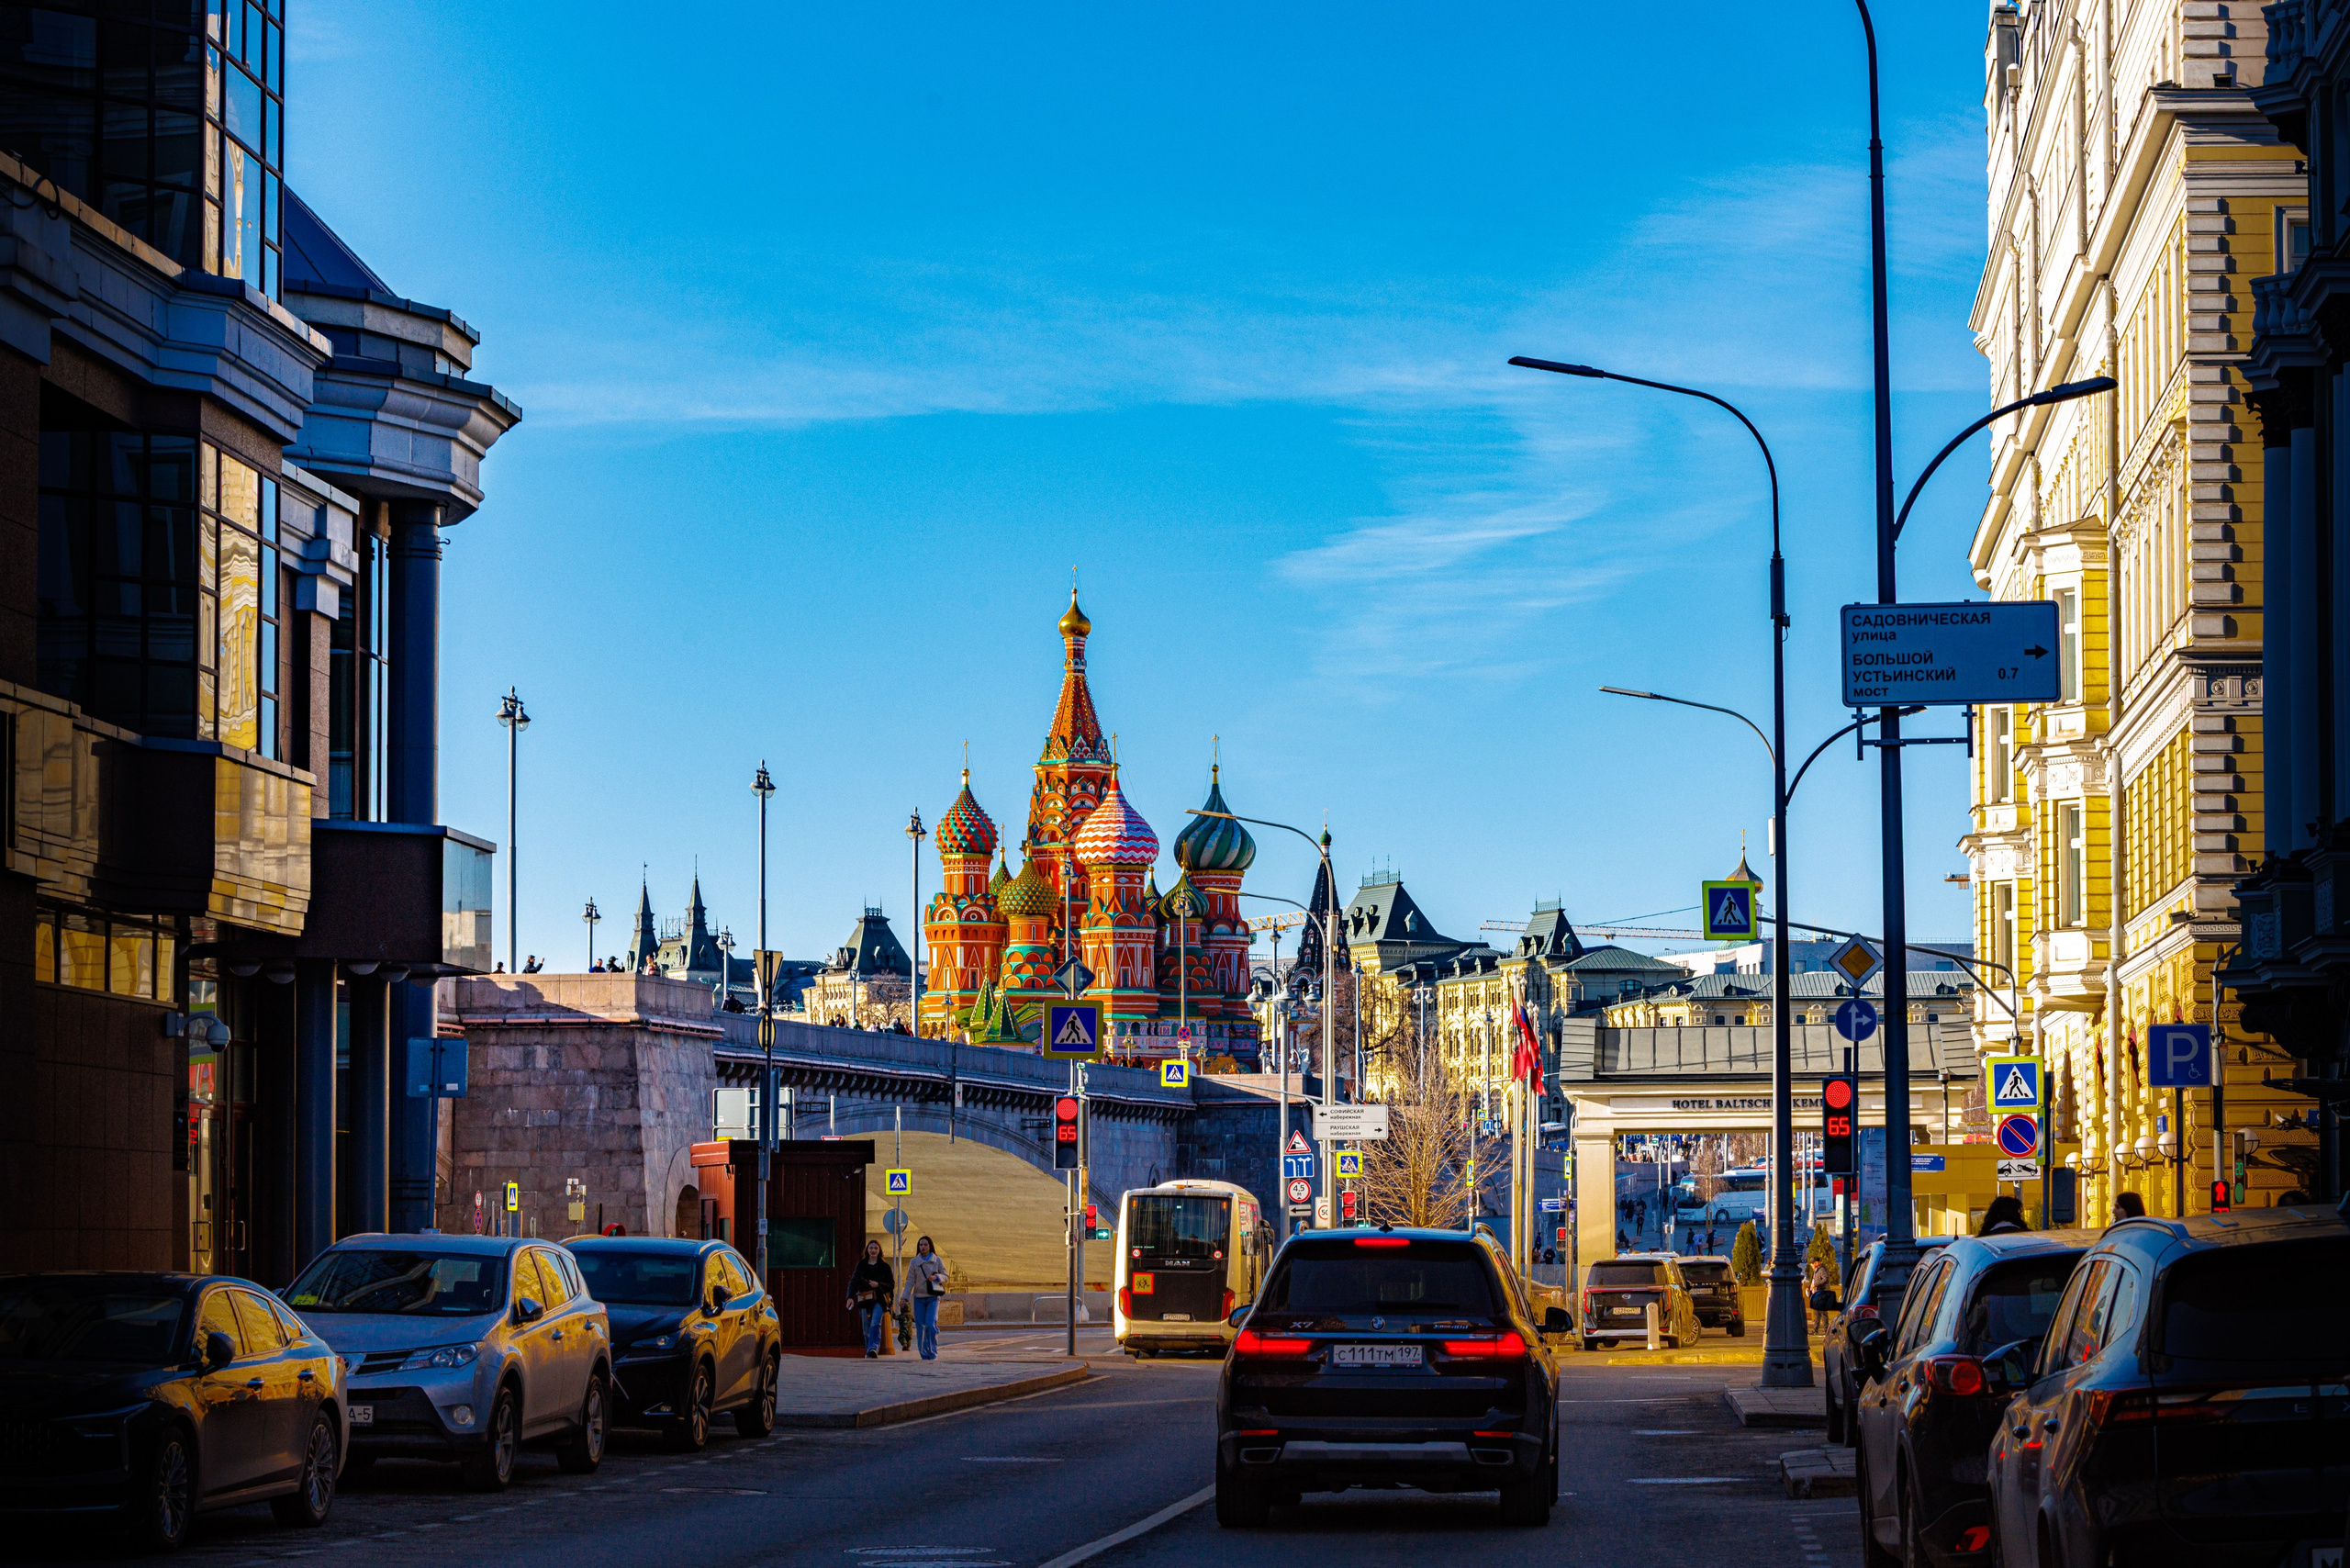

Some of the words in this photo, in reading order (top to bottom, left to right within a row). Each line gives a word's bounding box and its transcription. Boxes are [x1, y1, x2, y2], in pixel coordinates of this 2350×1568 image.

[1852, 612, 1991, 628] САДОВНИЧЕСКАЯ
[1852, 630, 1897, 644] улица
[1852, 650, 1934, 666] БОЛЬШОЙ
[1852, 666, 1956, 683] УСТЬИНСКИЙ
[1998, 667, 2019, 680] 0.7
[1852, 688, 1889, 698] мост
[2166, 1032, 2199, 1080] P
[1672, 1100, 1713, 1109] HOTEL
[1715, 1098, 1773, 1109] BALTSCH
[1058, 1126, 1077, 1141] 65
[1828, 1116, 1851, 1136] 65
[1086, 1218, 1096, 1227] 65
[1397, 1347, 1418, 1358] 197
